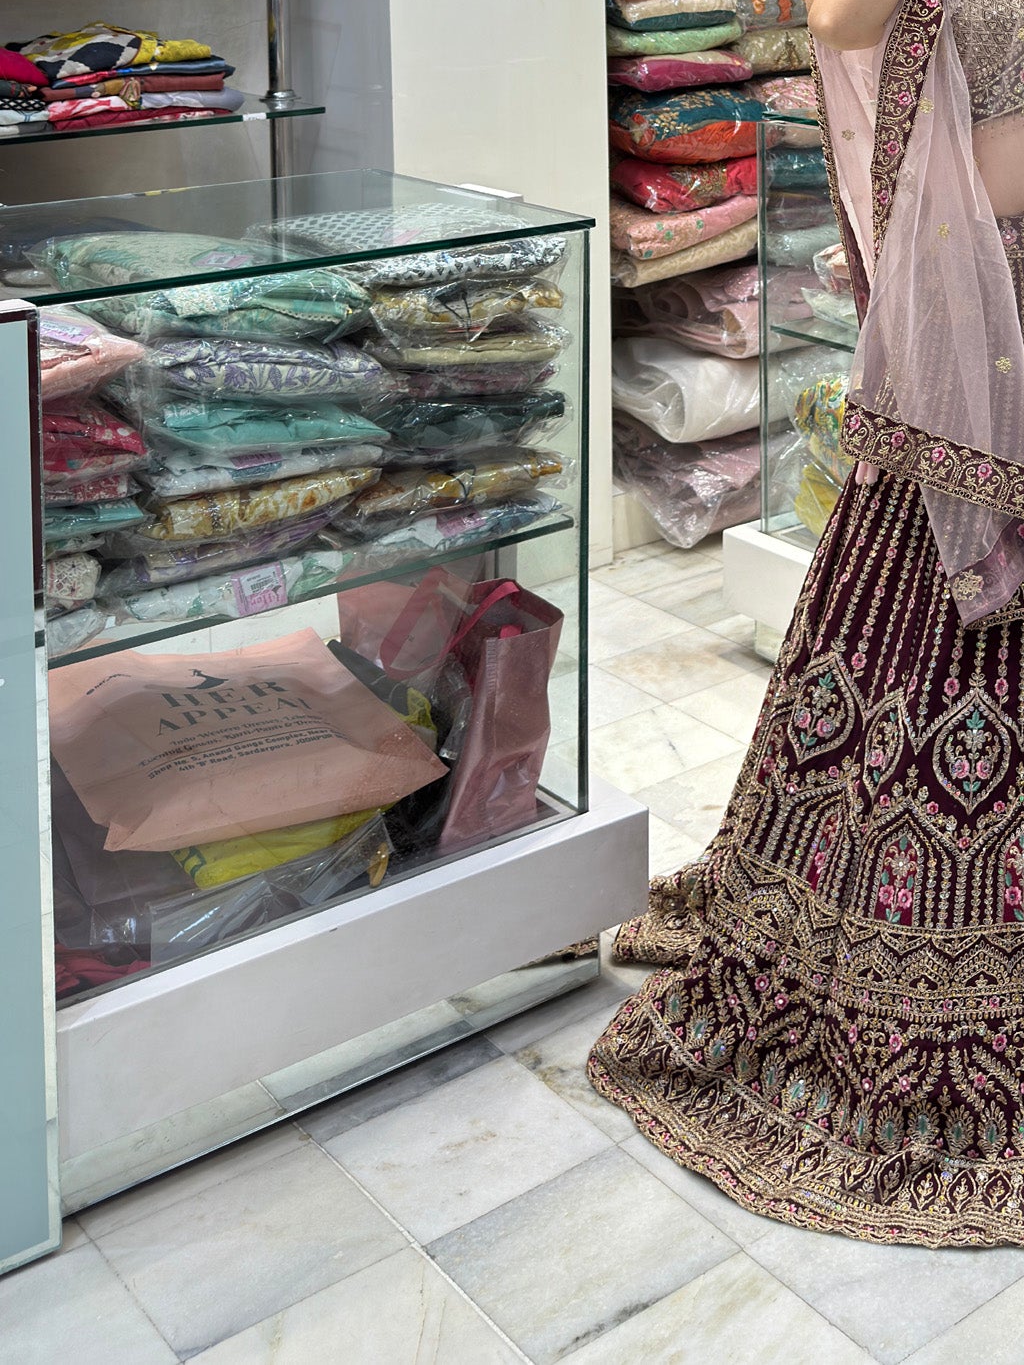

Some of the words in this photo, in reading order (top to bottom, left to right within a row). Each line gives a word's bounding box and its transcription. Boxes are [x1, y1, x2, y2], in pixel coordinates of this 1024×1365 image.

[161, 681, 289, 709] HER
[147, 763, 173, 780] Shop
[202, 747, 232, 759] Anand
